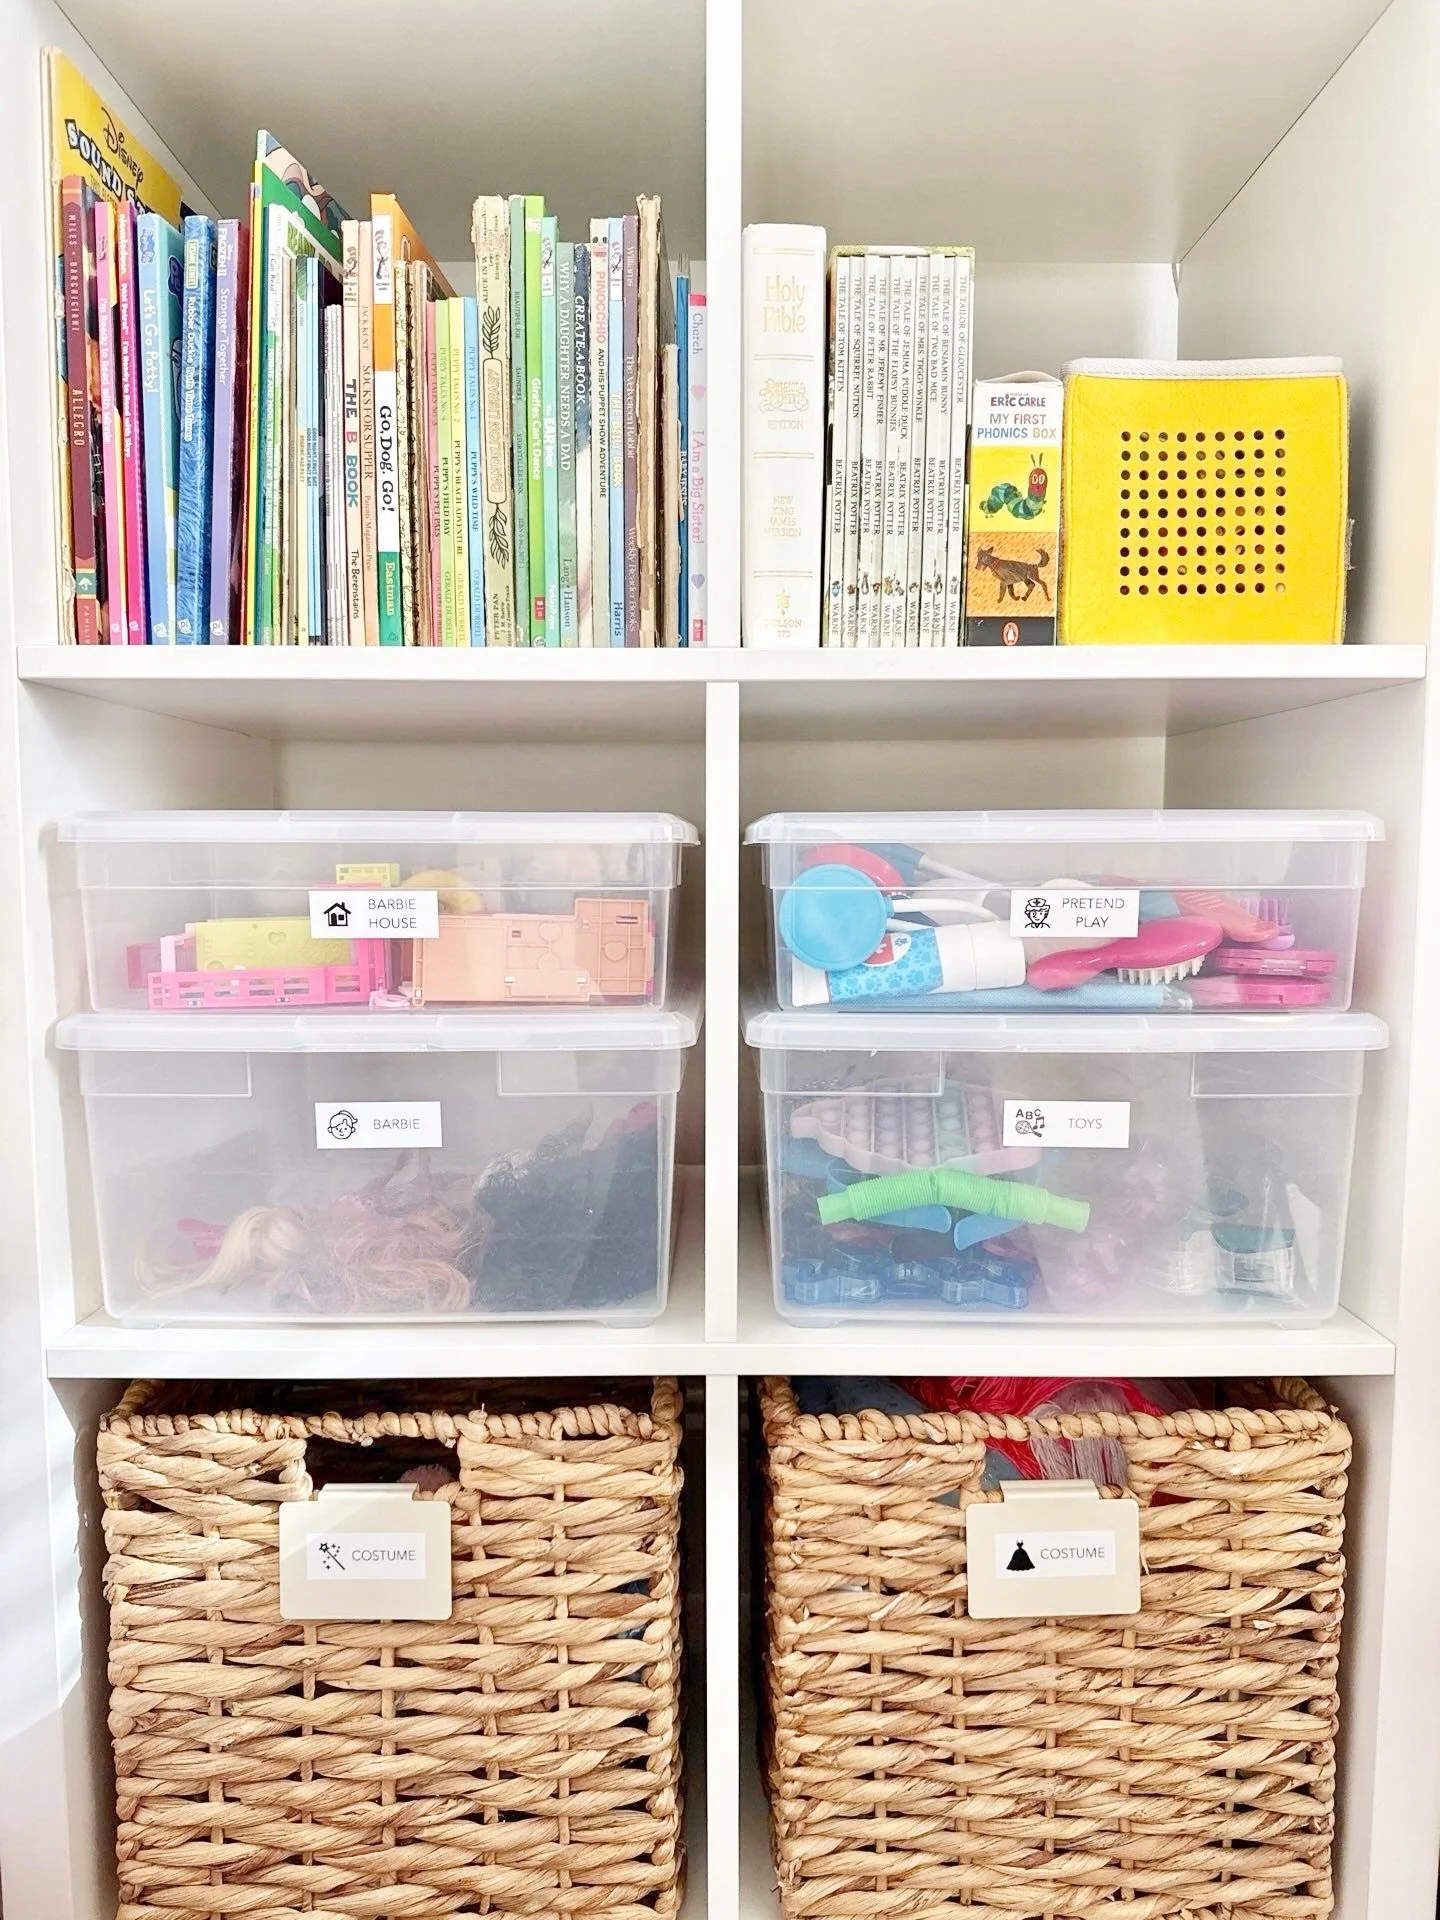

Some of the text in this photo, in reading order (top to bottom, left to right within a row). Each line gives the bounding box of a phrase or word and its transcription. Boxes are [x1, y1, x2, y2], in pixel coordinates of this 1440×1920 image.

[64, 119, 123, 200] SOUND
[68, 214, 77, 246] MILES
[188, 242, 198, 287] SESAME STREET
[218, 228, 228, 268] FROZEN
[627, 247, 635, 286] Williams
[596, 272, 606, 343] PINOCCHIO
[766, 275, 806, 307] Holy
[99, 315, 108, 345] Ready
[218, 288, 229, 384] Stronger Together
[692, 313, 703, 355] Church
[762, 306, 806, 333] Bible
[838, 323, 845, 334] OF
[854, 325, 861, 336] OF
[918, 322, 925, 333] OF
[942, 324, 949, 336] OF
[102, 348, 108, 358] to
[143, 290, 159, 393] Let's Go Potty!
[576, 296, 585, 403] CREATE-A-BOOK
[958, 332, 966, 343] OF
[184, 296, 197, 441] Rubber Duckie Bath Time Tunes
[559, 262, 570, 470] WHY A DAUGHTER NEEDS A DAD
[852, 339, 860, 382] SQUIRREL
[956, 346, 965, 404] GLOUCESTER
[102, 388, 112, 410] with
[124, 383, 130, 394] to
[626, 376, 634, 424] Velveteen
[916, 358, 924, 423] TIGGY-WINKLE
[990, 394, 1046, 407] ERIC CARLE
[72, 389, 86, 446] ALLEGRO
[103, 411, 112, 443] Minnie
[363, 366, 373, 479] SOCKS FOR SUPPER
[487, 370, 503, 492] DANDELION LIBRARY
[532, 378, 542, 480] Giraffes Can't Dance
[977, 428, 1057, 439] PHONICS BOX
[990, 414, 1047, 425] MY FIRST
[346, 379, 358, 508] THE B BOOK
[611, 392, 622, 488] THE BELLY BOOK
[627, 426, 636, 459] Rabbit
[692, 438, 703, 462] Am
[380, 406, 394, 512] Go, Dog. Go!
[691, 477, 703, 498] Big
[455, 506, 464, 556] ADVENTURE
[692, 501, 704, 544] Sister!
[952, 498, 960, 532] POTTER
[364, 522, 372, 553] Magazine
[351, 550, 360, 619] The Berenstains
[385, 562, 395, 616] Eastman
[561, 559, 573, 627] Lang Hanson
[627, 528, 637, 632] Weekly Reader Books
[614, 602, 623, 636] Harris
[368, 899, 416, 910] BARBIE
[1062, 898, 1125, 909] PRETEND
[369, 918, 417, 929] HOUSE
[1076, 916, 1109, 928] PLAY
[373, 1118, 420, 1130] BARBIE
[1068, 1118, 1103, 1129] TOYS
[352, 1550, 416, 1561] COSTUME
[1040, 1547, 1105, 1560] COSTUME
